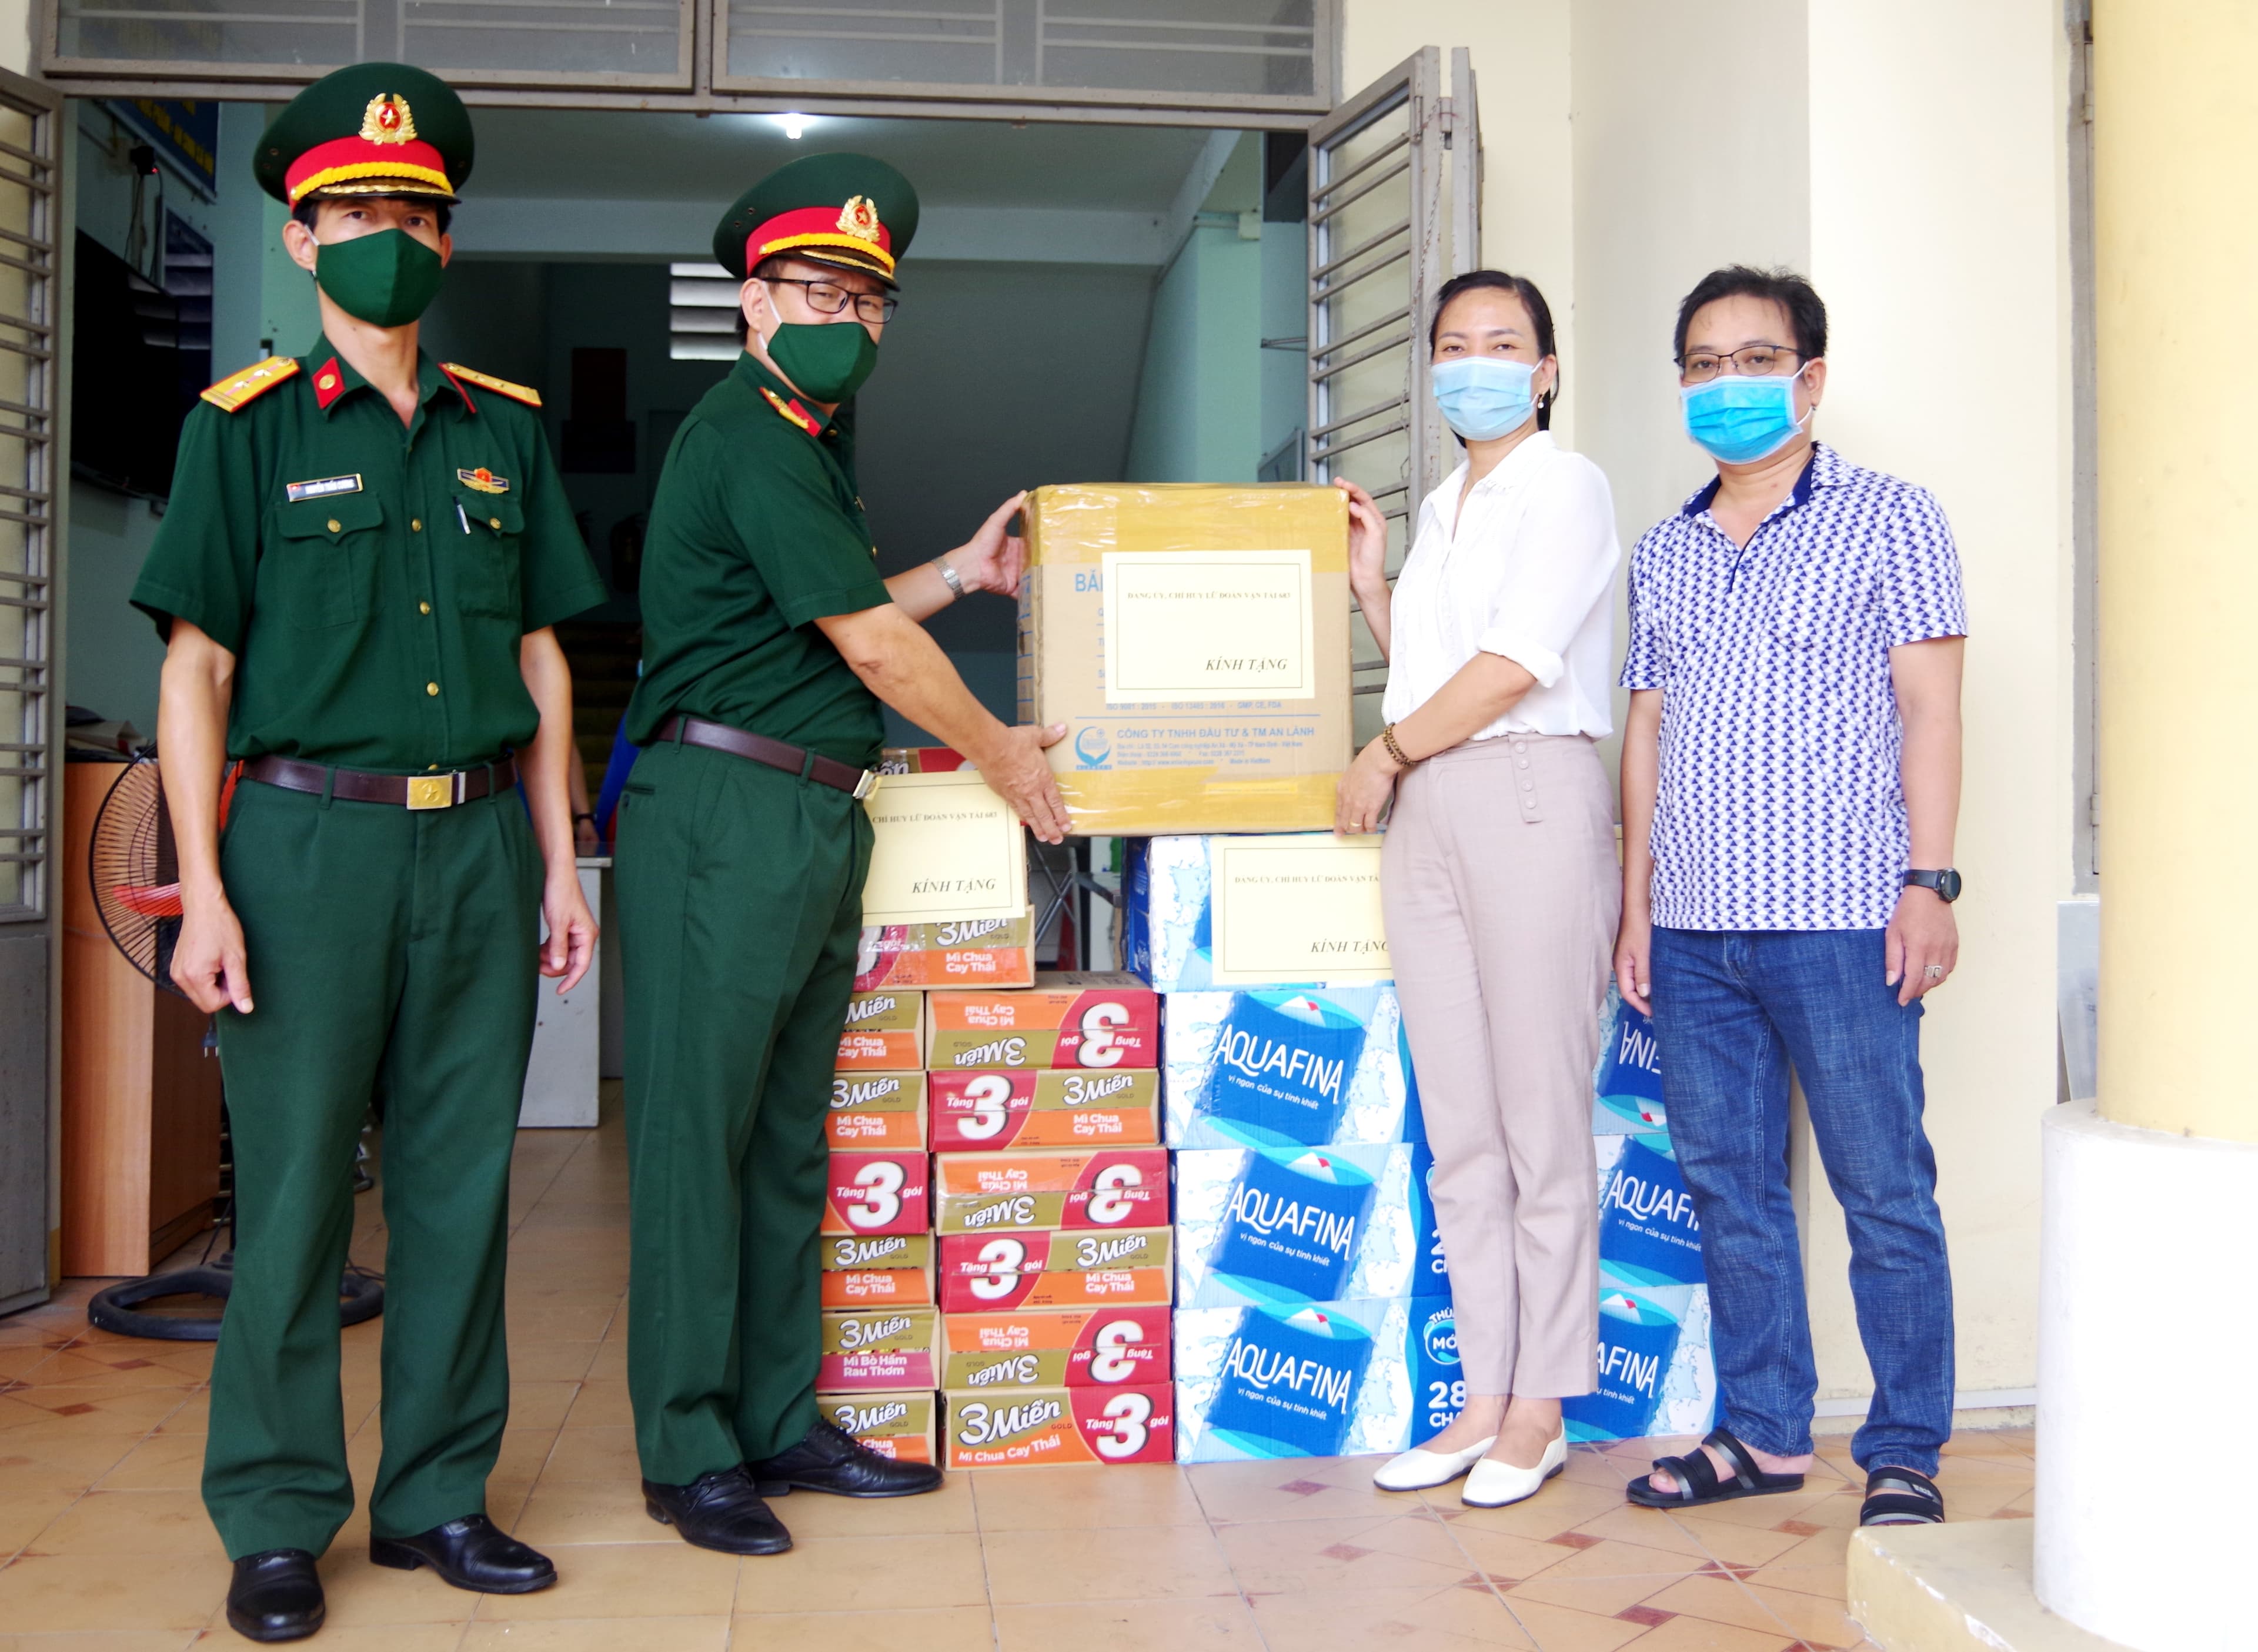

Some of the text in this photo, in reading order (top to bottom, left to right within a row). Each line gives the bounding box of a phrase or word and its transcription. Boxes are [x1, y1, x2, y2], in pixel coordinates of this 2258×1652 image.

[1075, 569, 1103, 592] BĂ
[1205, 656, 1288, 673] KÍNH TẶNG
[1117, 728, 1148, 738] CÔNG
[1151, 729, 1164, 738] TY
[1167, 729, 1195, 738] TNHH
[1225, 728, 1238, 737] TƯ
[1252, 728, 1266, 737] TM
[1269, 727, 1283, 736] AN
[1287, 725, 1314, 736] LÀNH
[1369, 872, 1379, 882] TẢ
[912, 878, 996, 894] KÍNH TẶNG
[1311, 938, 1348, 952] KÍNH
[946, 952, 993, 962] Mì Chua
[946, 961, 996, 974] Cay Thái
[965, 1005, 1014, 1015] Cay Thái
[968, 1015, 1014, 1025] Mì Chua
[853, 1036, 884, 1046] Chua
[1061, 1002, 1141, 1067] Tặng 3 gói
[837, 1046, 887, 1058] Cay Thái
[1211, 1024, 1344, 1105] AQUAFINA
[1228, 1075, 1319, 1110] vị ngon của sự tinh khiết
[947, 1075, 1028, 1139] Tặng 3 gói
[837, 1116, 883, 1125] Mì Chua
[1074, 1113, 1119, 1123] Mì Chua
[837, 1125, 887, 1138] Cay Thái
[1073, 1122, 1122, 1135] Cay Thái
[836, 1161, 923, 1228] Tặng 3 gói
[1070, 1164, 1150, 1223] Tặng 3 gói
[1602, 1169, 1699, 1231] AQUAFI
[1223, 1181, 1355, 1261] AQUAFINA
[1625, 1221, 1643, 1232] ngon
[1645, 1228, 1659, 1238] của
[1660, 1233, 1670, 1242] sự
[1671, 1236, 1685, 1246] tinh
[1685, 1240, 1701, 1252] khiết
[1240, 1232, 1330, 1266] vị ngon của sự tinh khiết
[961, 1262, 987, 1273] Tặng
[971, 1238, 1023, 1299] 3
[1024, 1260, 1043, 1272] gói
[846, 1273, 892, 1283] Mì Chua
[1086, 1272, 1131, 1282] Mì Chua
[846, 1283, 896, 1296] Cay Thái
[1086, 1281, 1134, 1293] Cay Thái
[980, 1326, 1028, 1338] Cay Thái
[983, 1337, 1028, 1347] Mì Chua
[1073, 1320, 1153, 1382] Tặng 3 gói
[844, 1356, 858, 1366] Mì
[861, 1356, 877, 1365] Bò
[844, 1366, 904, 1377] Rau Thơm
[1221, 1337, 1351, 1414] AQUAFINA
[1597, 1342, 1659, 1399] AFINA
[1428, 1380, 1467, 1409] 28
[1238, 1387, 1327, 1420] vị ngon của sự tinh khiết
[1086, 1393, 1169, 1458] Tặng 3 gói
[863, 1439, 893, 1449] Chua
[958, 1434, 1061, 1462] Mì Chua Cay Thái
